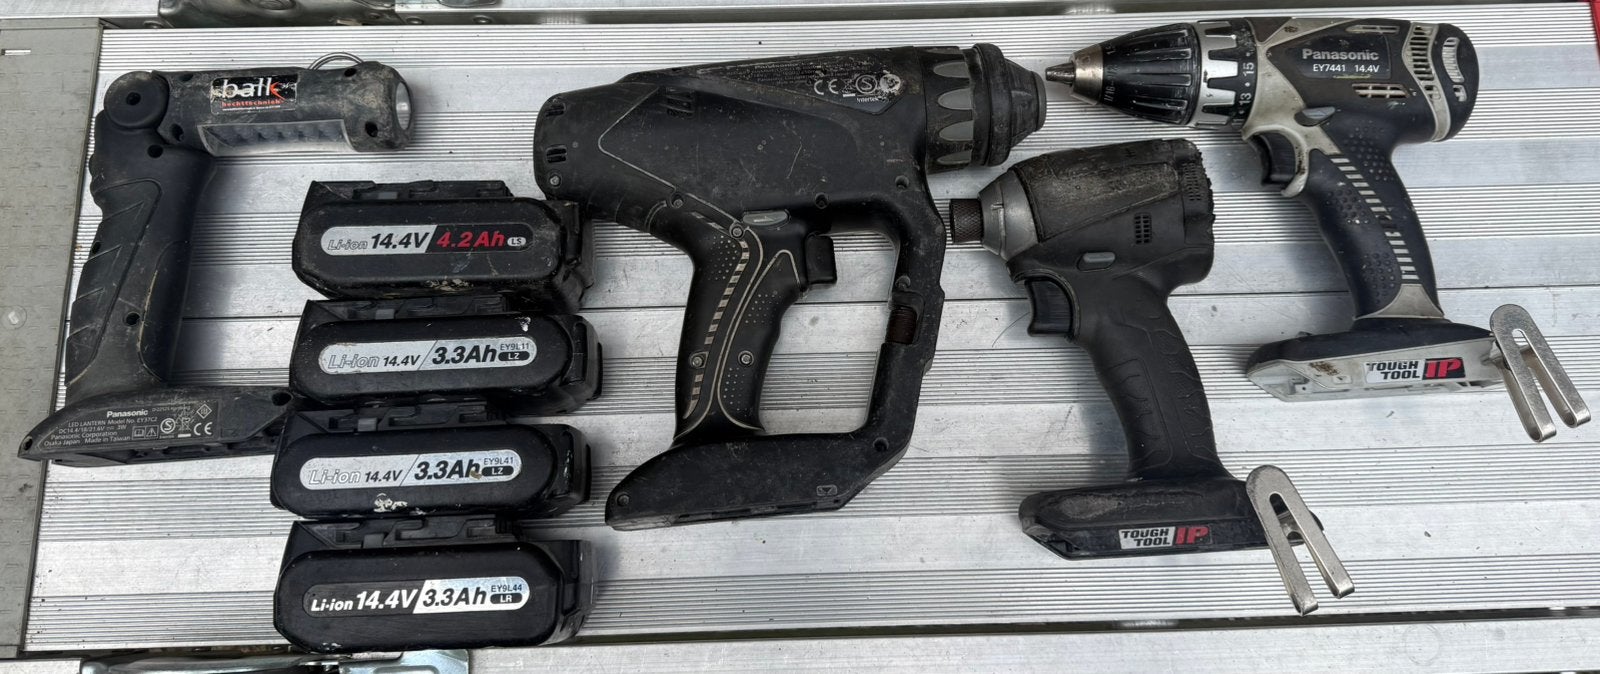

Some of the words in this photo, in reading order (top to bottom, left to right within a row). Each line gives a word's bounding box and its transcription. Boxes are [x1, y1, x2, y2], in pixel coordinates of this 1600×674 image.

[1302, 48, 1379, 60] Panasonic
[1243, 62, 1255, 77] 15
[1312, 63, 1346, 72] EY7441
[1355, 64, 1380, 73] 14.4V
[1240, 92, 1252, 106] 13
[328, 239, 367, 250] Li-ion
[371, 232, 429, 249] 14.4V
[500, 343, 530, 351] EY9L11
[432, 344, 497, 364] 3.3Ah
[328, 354, 379, 369] Li-ion
[384, 355, 420, 367] 14.4V
[1366, 361, 1418, 371] TOUGH
[1425, 358, 1461, 378] IP
[1380, 370, 1420, 380] TOOL
[106, 409, 149, 418] Panasonic
[81, 431, 118, 439] Corporation
[483, 457, 514, 465] EY9L41
[415, 459, 480, 480] 3.3Ah
[309, 469, 361, 484] Li-ion
[365, 470, 402, 482] 14.4V
[1121, 529, 1169, 538] TOUGH
[1176, 527, 1209, 544] IP
[1134, 537, 1170, 546] TOOL
[491, 584, 523, 593] EY9L44
[311, 599, 353, 612] Li-ion
[356, 589, 419, 610] 14.4V
[423, 587, 487, 607] 3.3Ah
